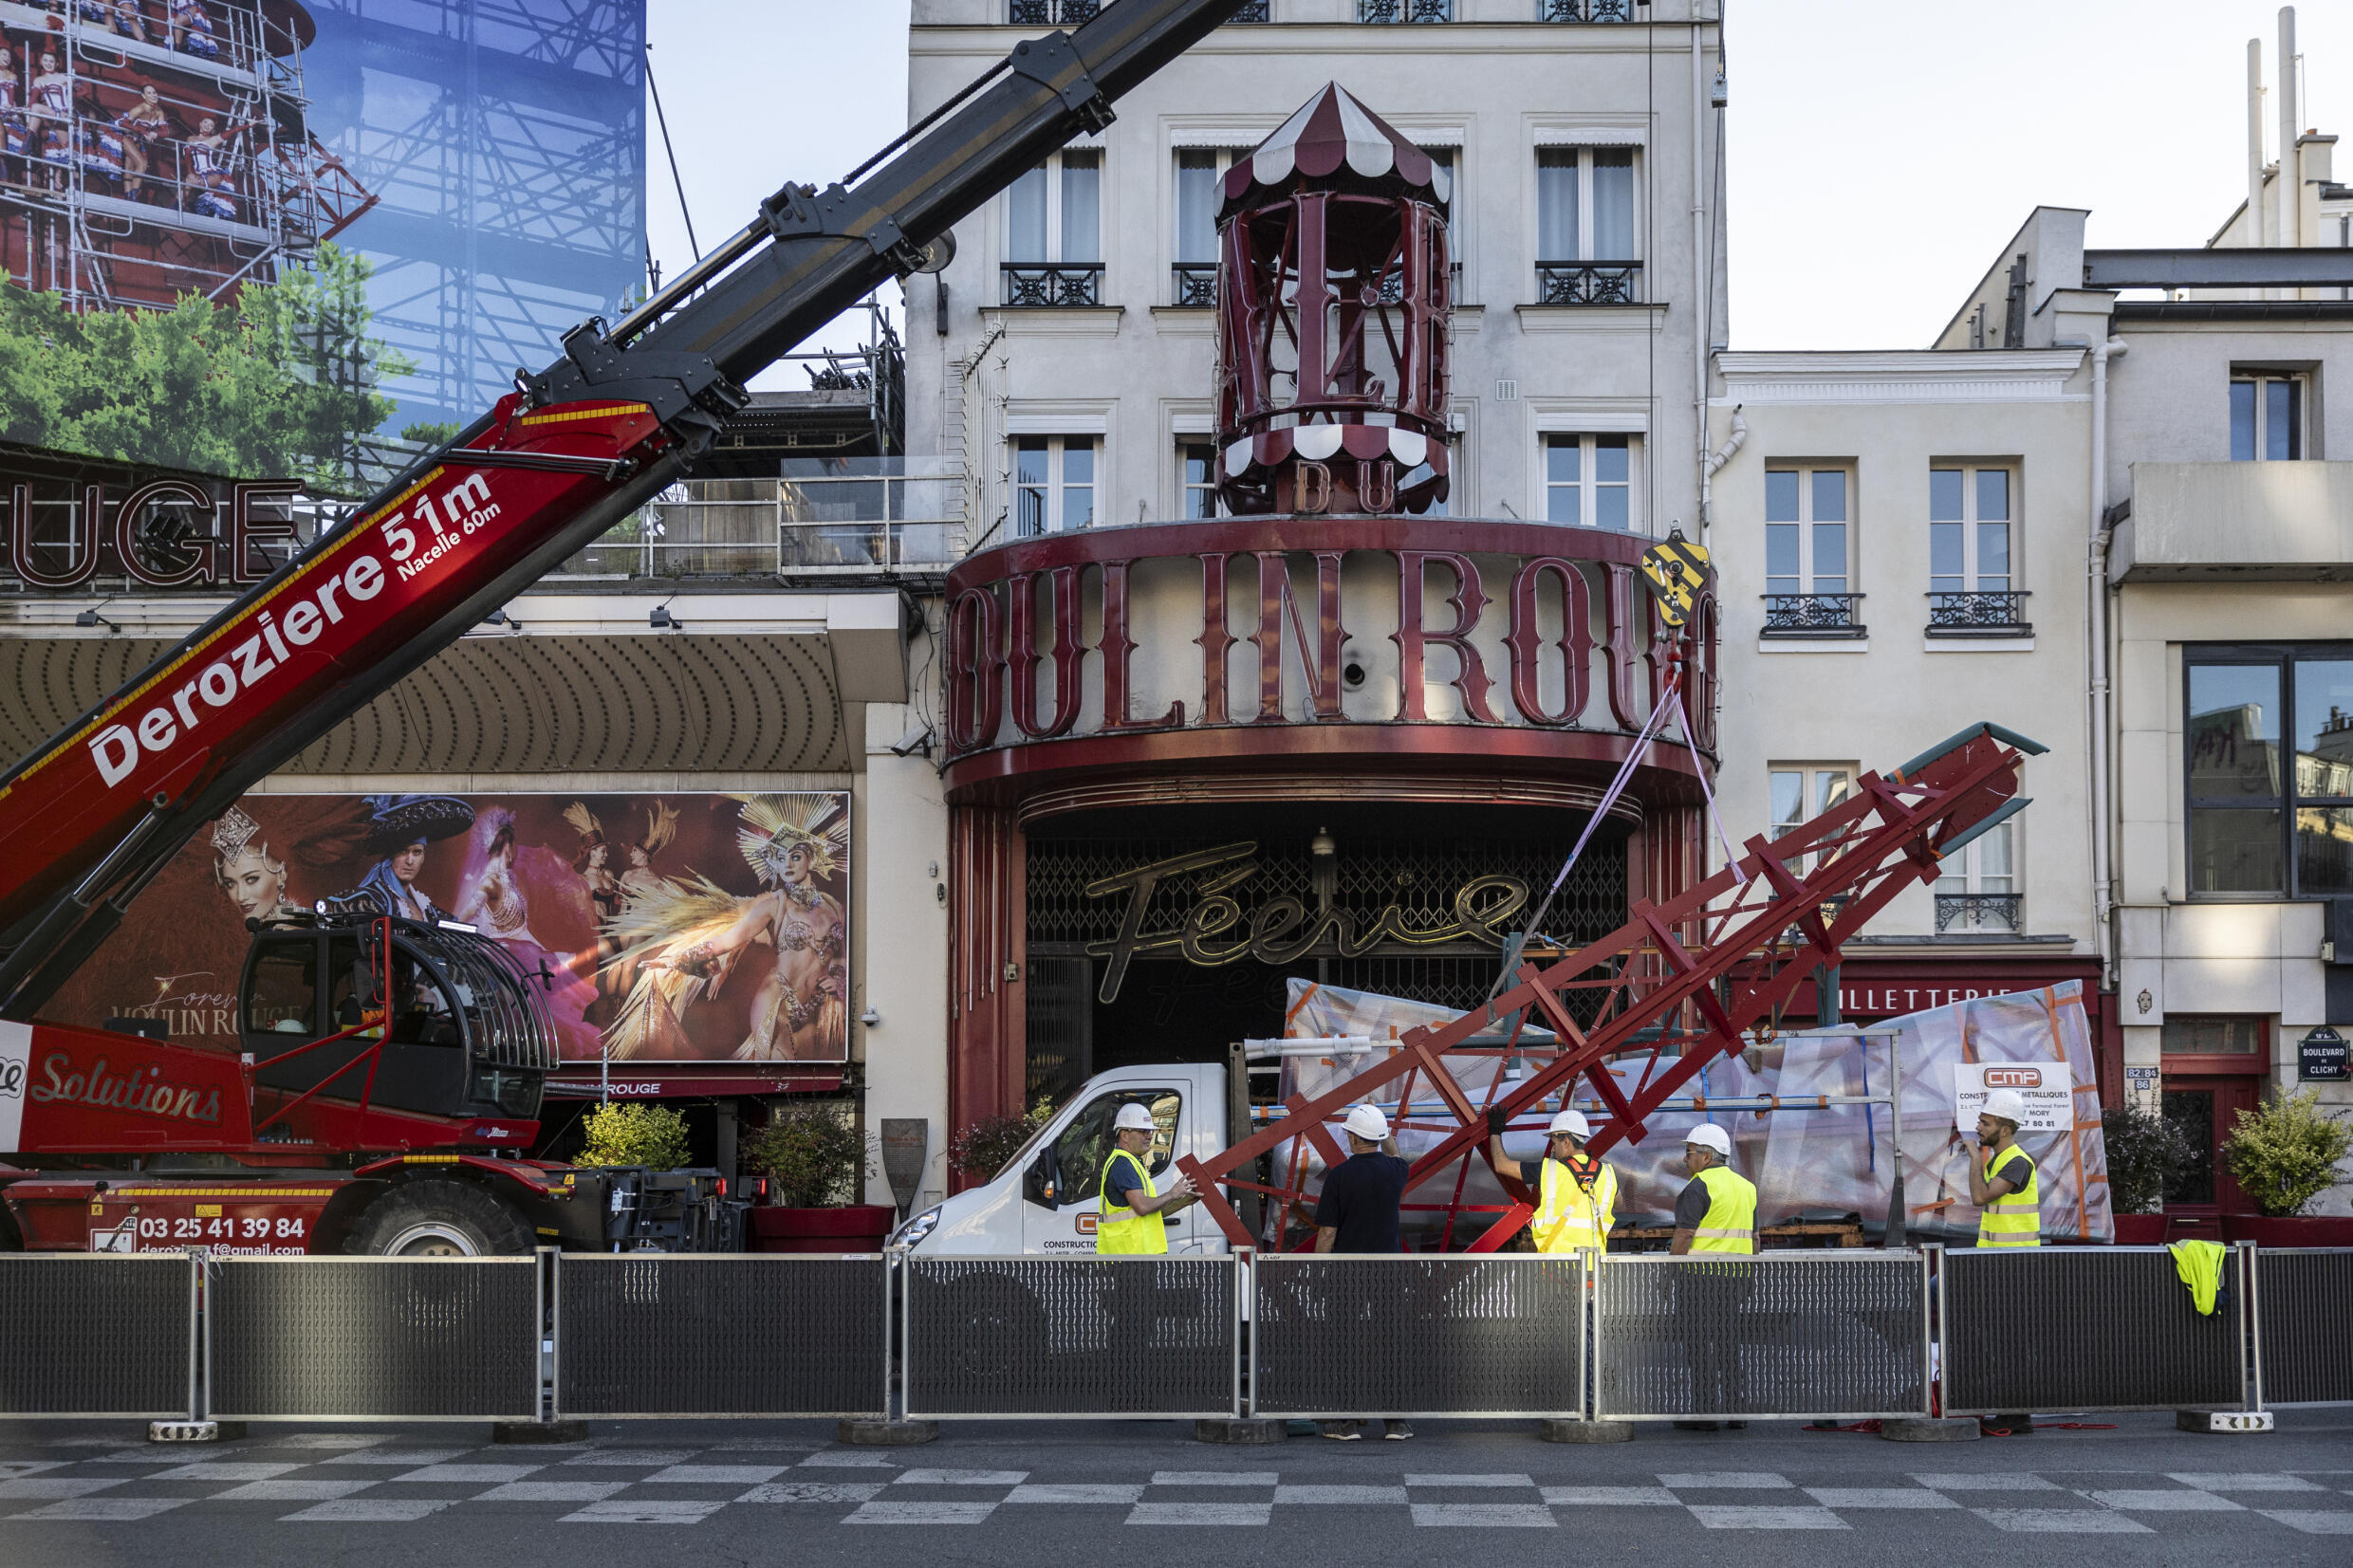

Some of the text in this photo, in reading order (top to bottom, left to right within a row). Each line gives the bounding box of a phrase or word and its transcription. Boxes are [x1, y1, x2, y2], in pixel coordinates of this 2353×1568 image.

[1294, 460, 1395, 513] DU
[396, 500, 501, 581] Nacelle 60m
[88, 472, 491, 788] Deroziere 51m
[945, 550, 1354, 749] OULIN
[1084, 840, 1529, 1004] Féerie
[29, 1052, 220, 1122] Solutions
[1988, 1071, 2037, 1085] CMP
[2128, 1069, 2157, 1078] 82 84
[2136, 1080, 2149, 1089] 86
[2310, 1065, 2338, 1074] CLICHY
[607, 1083, 661, 1095] ROUGE
[139, 1218, 305, 1238] 03 25 41 39 84
